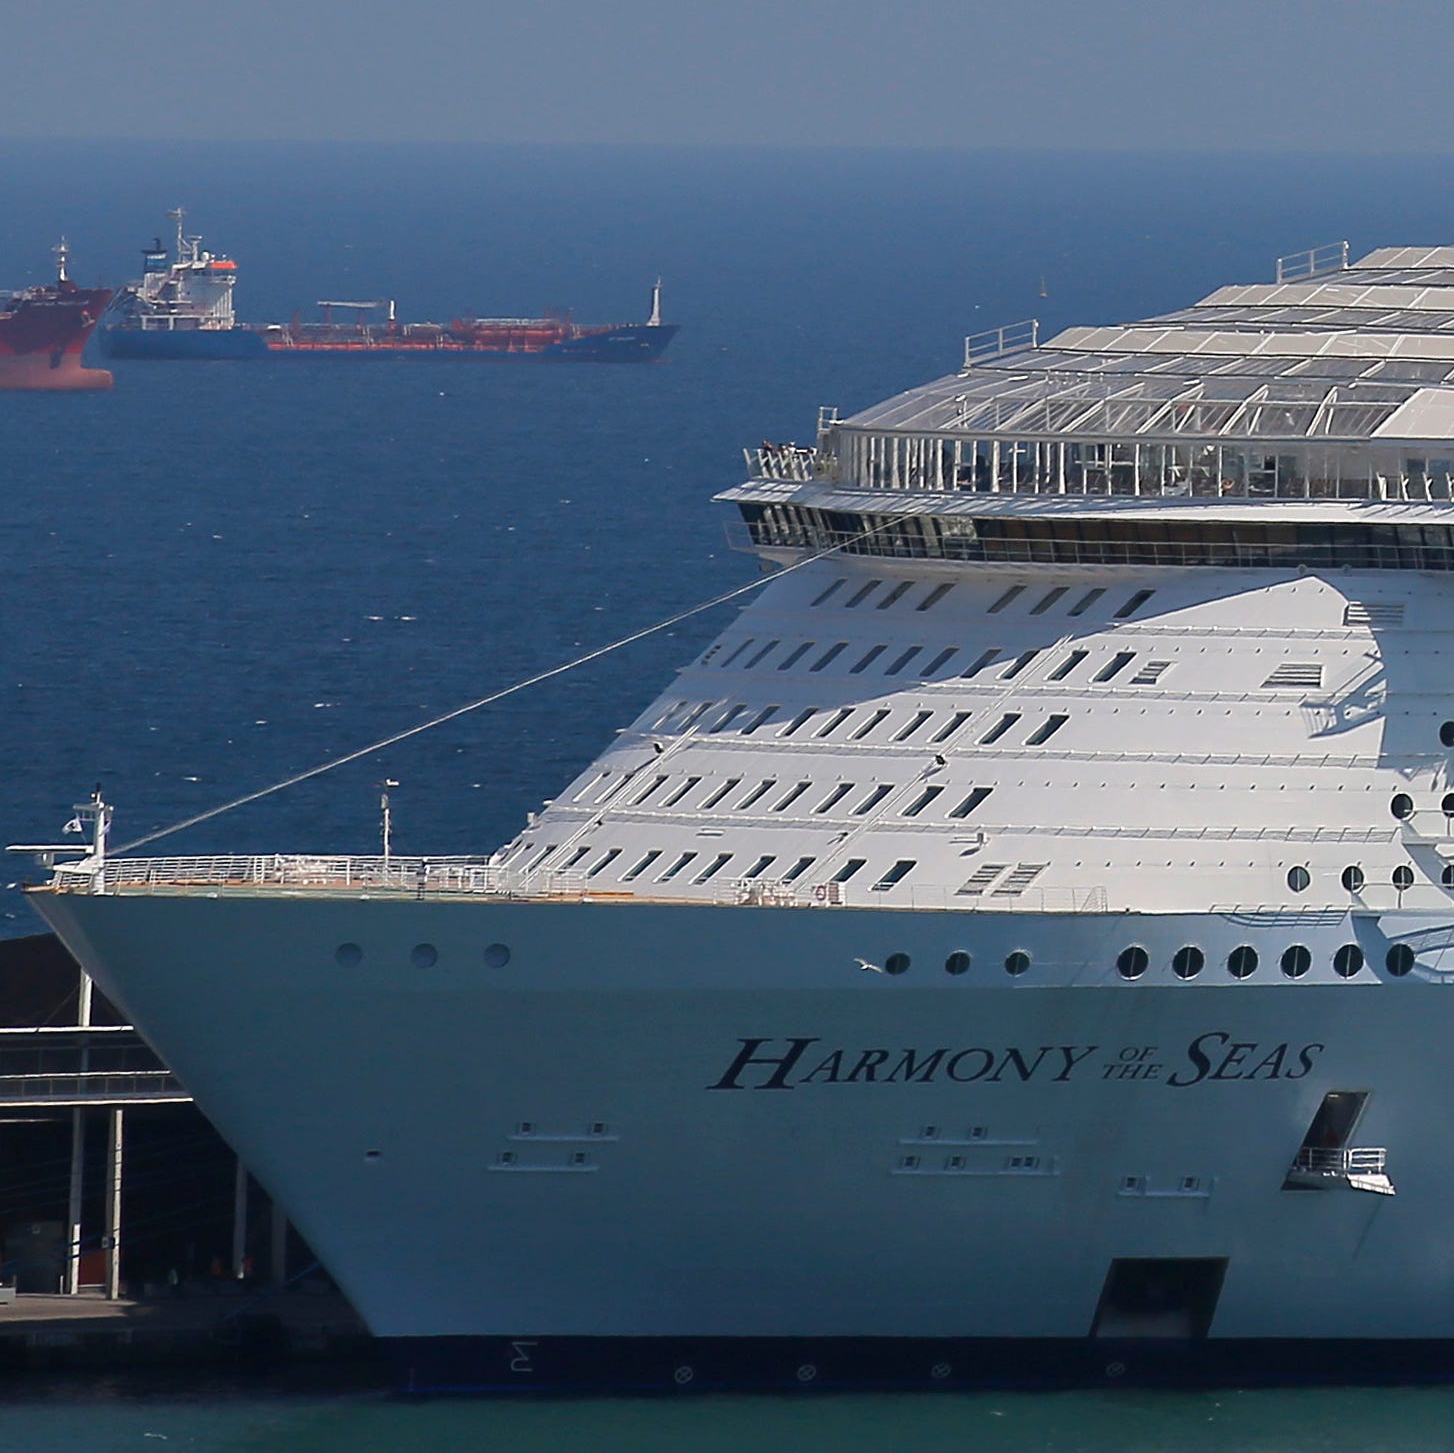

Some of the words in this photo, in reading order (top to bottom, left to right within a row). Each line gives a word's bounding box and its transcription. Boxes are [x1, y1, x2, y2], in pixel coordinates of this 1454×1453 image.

[705, 1038, 1098, 1090] HARMONY
[1102, 1063, 1163, 1079] THE
[1119, 1047, 1160, 1062] OF
[1166, 1031, 1324, 1087] SEAS
